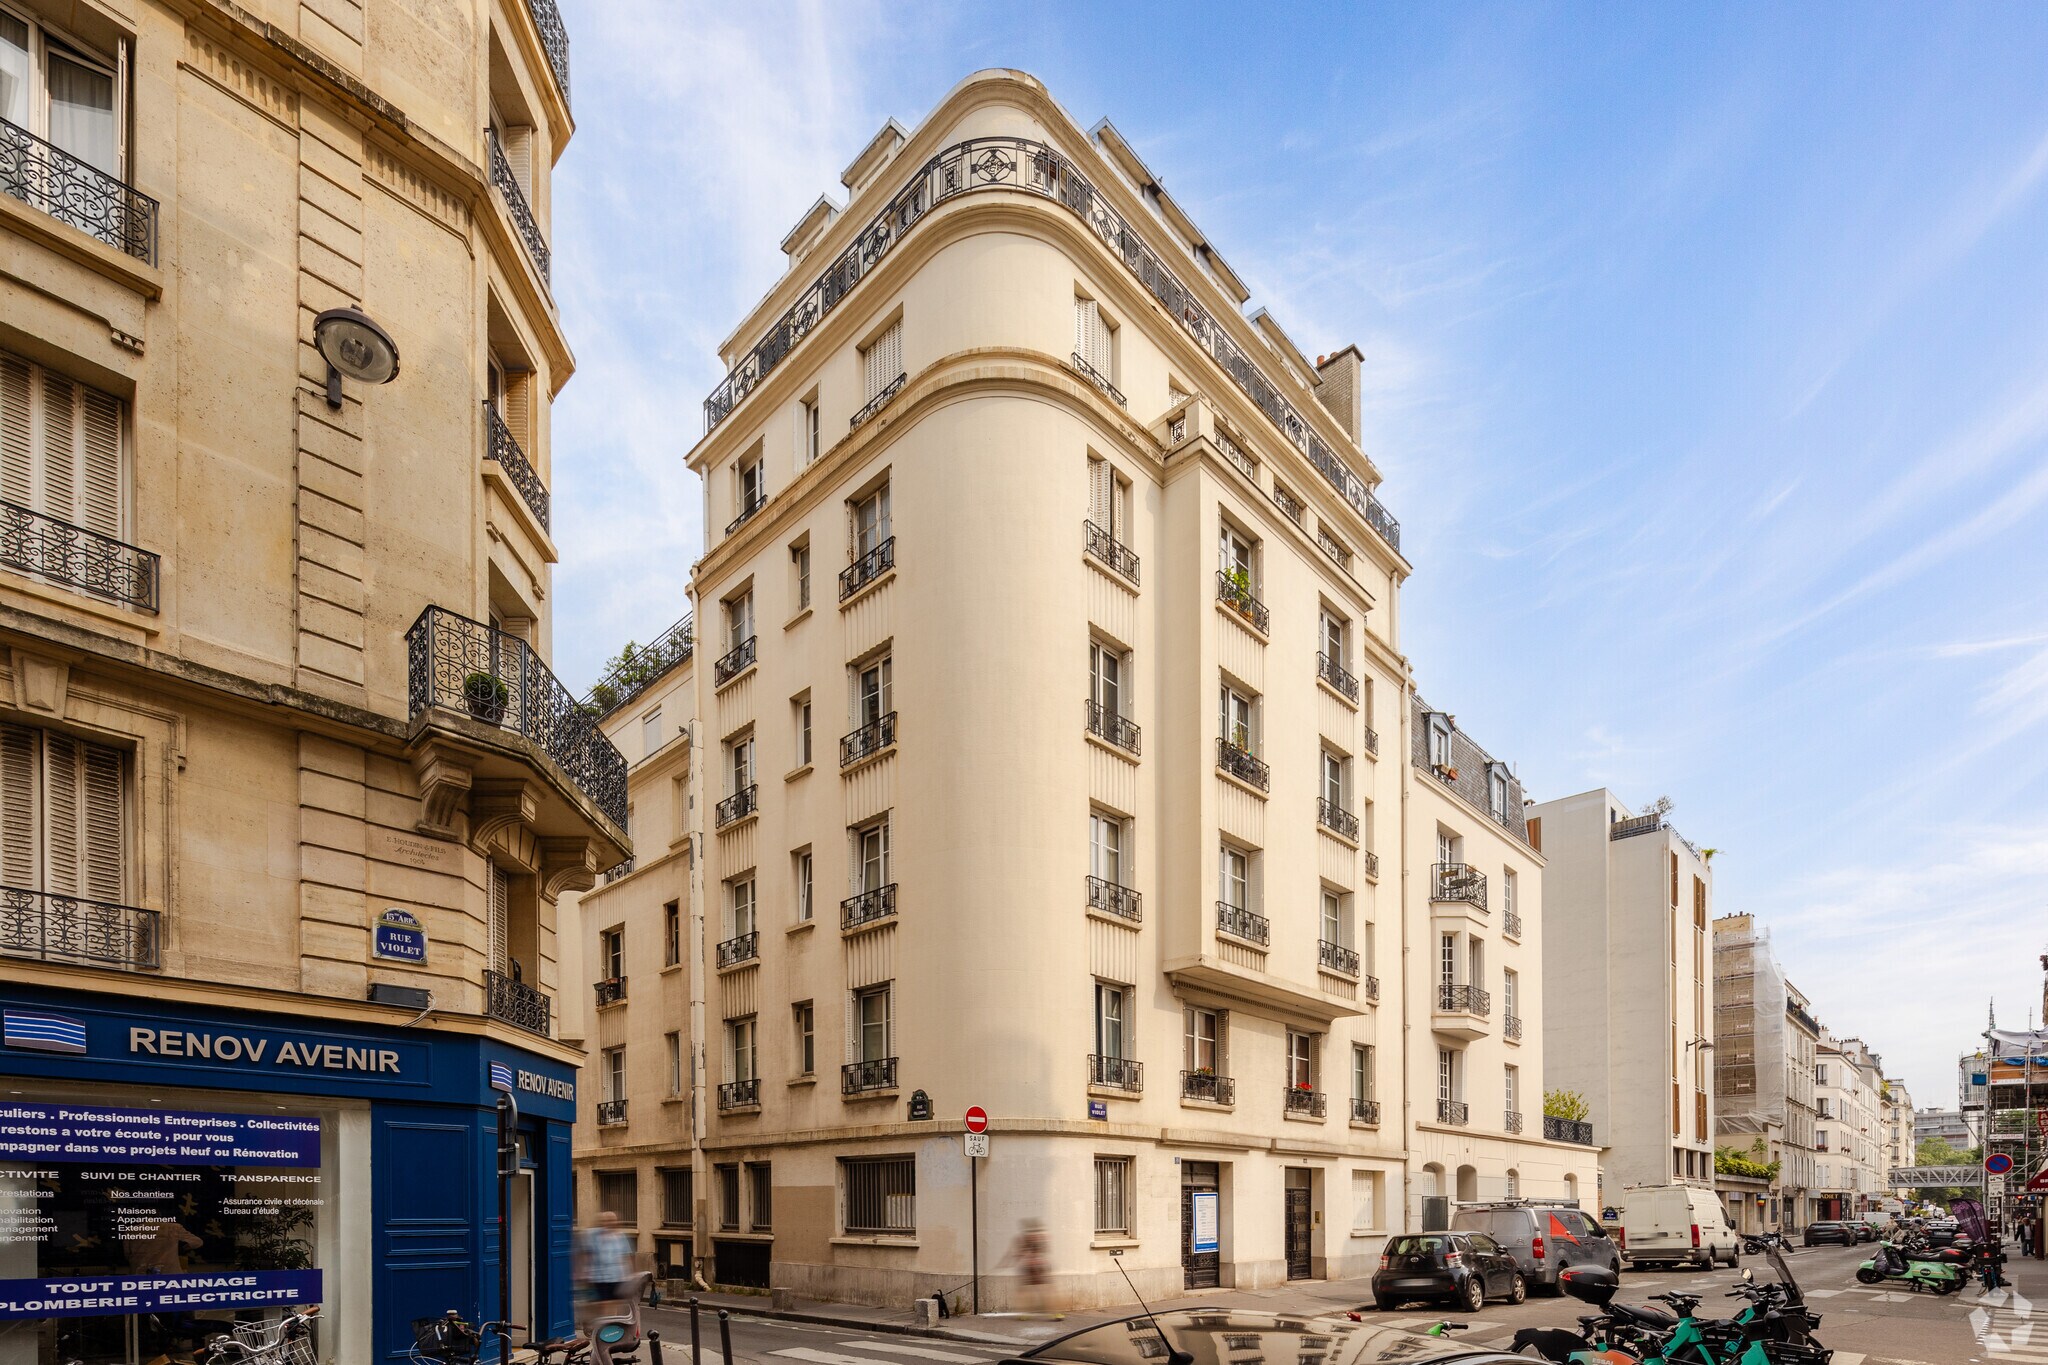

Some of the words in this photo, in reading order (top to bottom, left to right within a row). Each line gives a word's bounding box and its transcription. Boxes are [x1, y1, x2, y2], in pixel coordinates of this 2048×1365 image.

[390, 933, 412, 943] RUE
[380, 942, 421, 956] VIOLET
[130, 1027, 267, 1062] RENOV
[276, 1041, 400, 1073] AVENIR
[518, 1070, 547, 1094] RENOV
[547, 1077, 574, 1101] AVENIR
[59, 1110, 161, 1125] Professionnels
[164, 1116, 237, 1128] Entreprises
[247, 1119, 320, 1131] Collectivités
[1, 1126, 57, 1136] restons
[75, 1128, 111, 1138] votre
[115, 1128, 162, 1140] écoute
[173, 1133, 202, 1142] pour
[65, 1143, 99, 1153] dans
[103, 1146, 126, 1154] vos
[130, 1145, 177, 1156] projets
[181, 1146, 211, 1156] Neuf
[214, 1149, 229, 1157] ou
[233, 1148, 299, 1159] Rénovation
[81, 1172, 114, 1180] SUIVI
[118, 1172, 136, 1180] DE
[139, 1173, 201, 1182] CHANTIER
[220, 1174, 321, 1182] TRANSPARENCE
[111, 1190, 130, 1198] Nos
[132, 1190, 174, 1198] chantiers
[223, 1198, 262, 1206] Assurance
[284, 1198, 291, 1206] et
[117, 1207, 156, 1215] Maisons
[224, 1207, 251, 1215] Bureau
[252, 1207, 279, 1215] d'étude
[117, 1216, 176, 1224] Appartement
[118, 1224, 160, 1232] Exterieur
[46, 1282, 114, 1294] TOUT
[121, 1277, 257, 1291] DEPANNAGE
[159, 1289, 299, 1305] ELECTRICITE
